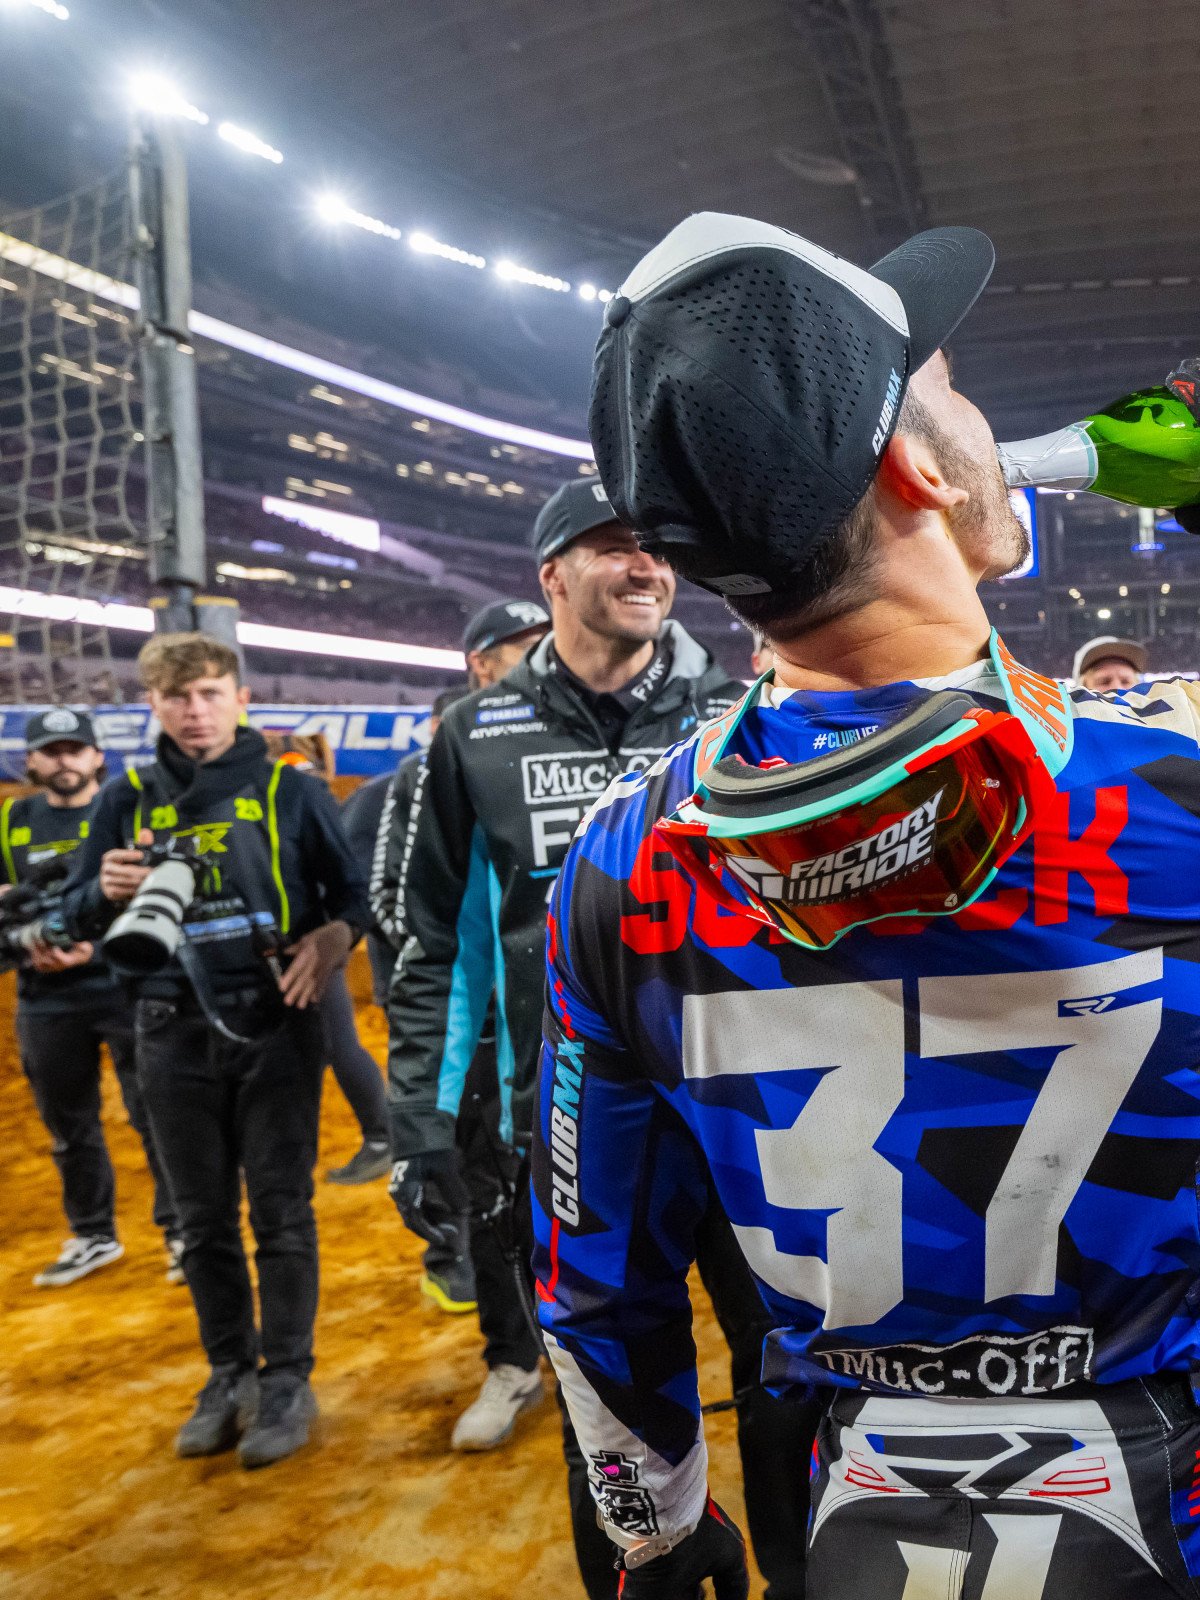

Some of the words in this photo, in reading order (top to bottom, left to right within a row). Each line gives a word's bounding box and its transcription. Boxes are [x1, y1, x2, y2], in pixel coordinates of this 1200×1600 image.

[872, 366, 902, 456] CLUBMX
[788, 788, 944, 880] FACTORY
[868, 856, 931, 893] OPTICS
[551, 1025, 586, 1228] CLUBMX
[682, 946, 1164, 1331] 37
[833, 1335, 1083, 1395] Muc-Off
